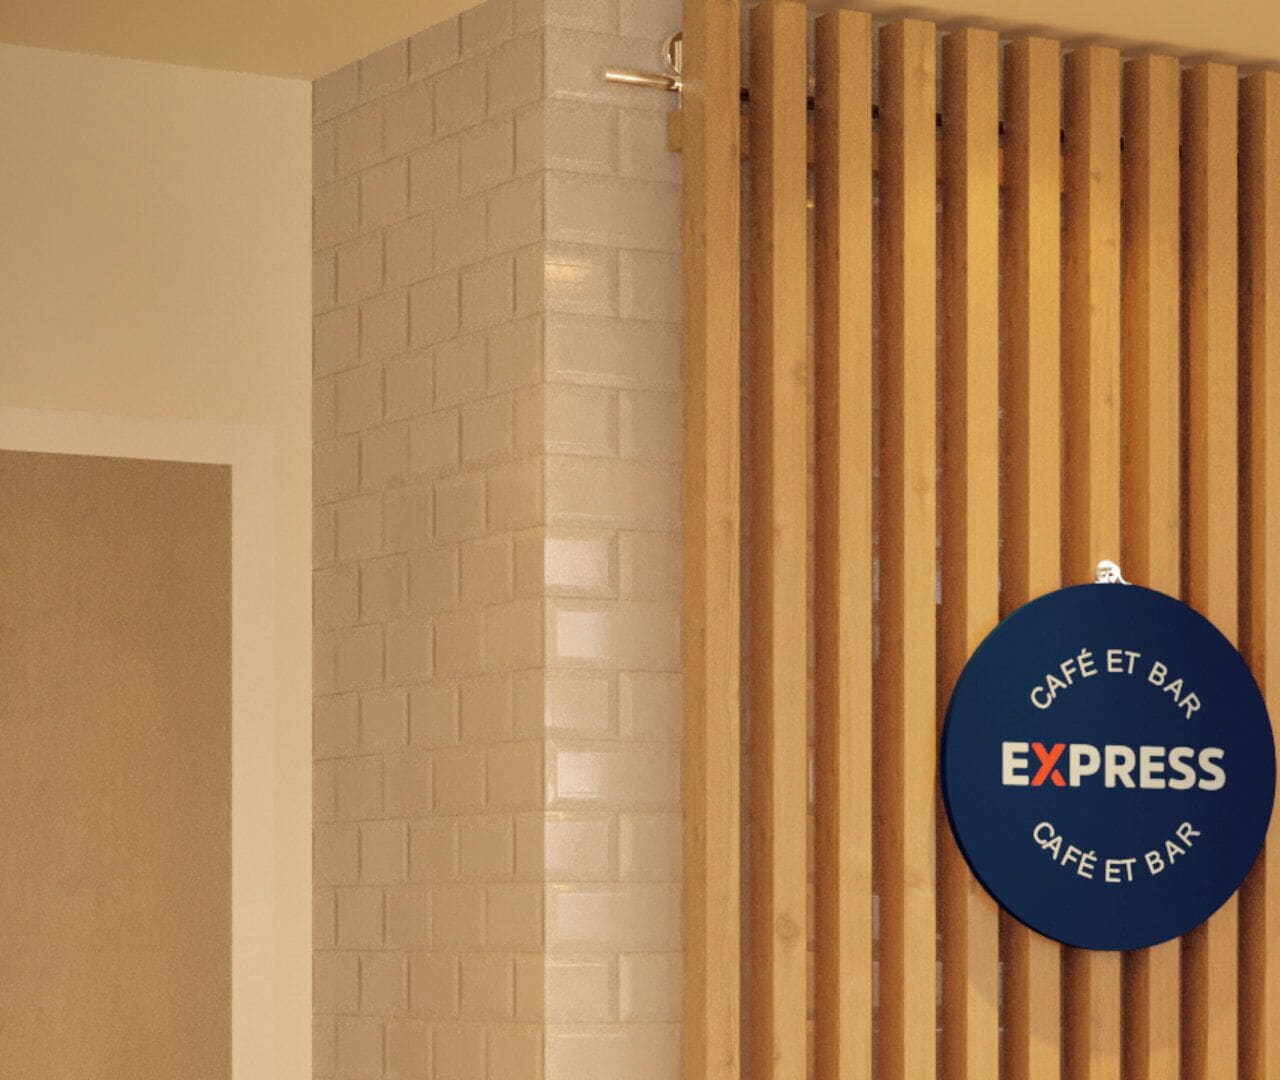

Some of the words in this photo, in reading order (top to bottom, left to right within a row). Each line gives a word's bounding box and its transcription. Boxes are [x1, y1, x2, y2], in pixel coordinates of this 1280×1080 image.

[1030, 647, 1098, 709] CAFÉ
[1106, 649, 1141, 674] ET
[1148, 661, 1201, 718] BAR
[1001, 741, 1226, 790] EXPRESS
[1032, 821, 1098, 879] CAFÉ
[1104, 858, 1137, 883] ET
[1144, 821, 1201, 875] BAR
